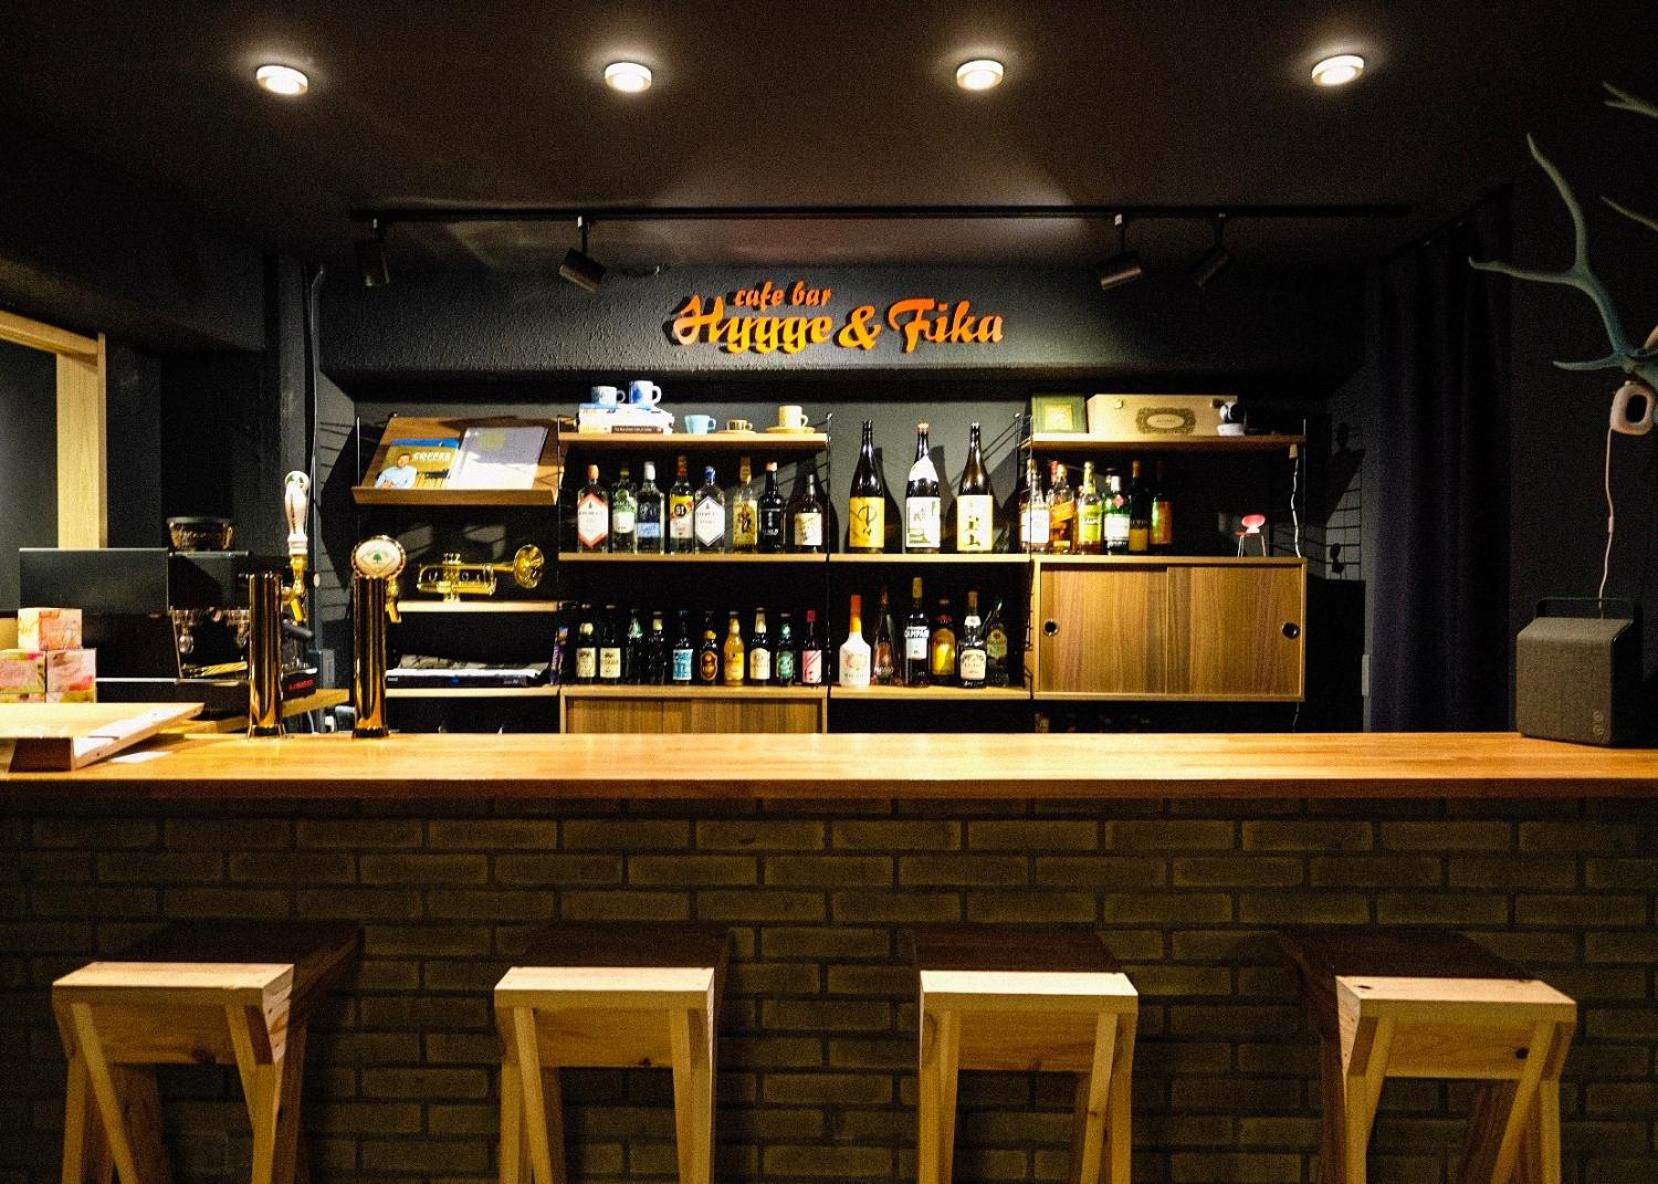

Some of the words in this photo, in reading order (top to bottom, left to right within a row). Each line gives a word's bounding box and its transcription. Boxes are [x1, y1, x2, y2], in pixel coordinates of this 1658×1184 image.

[735, 280, 785, 311] cafe
[792, 279, 832, 306] bar
[673, 294, 833, 353] Hygge
[838, 304, 882, 350] &
[888, 298, 1003, 353] Fika
